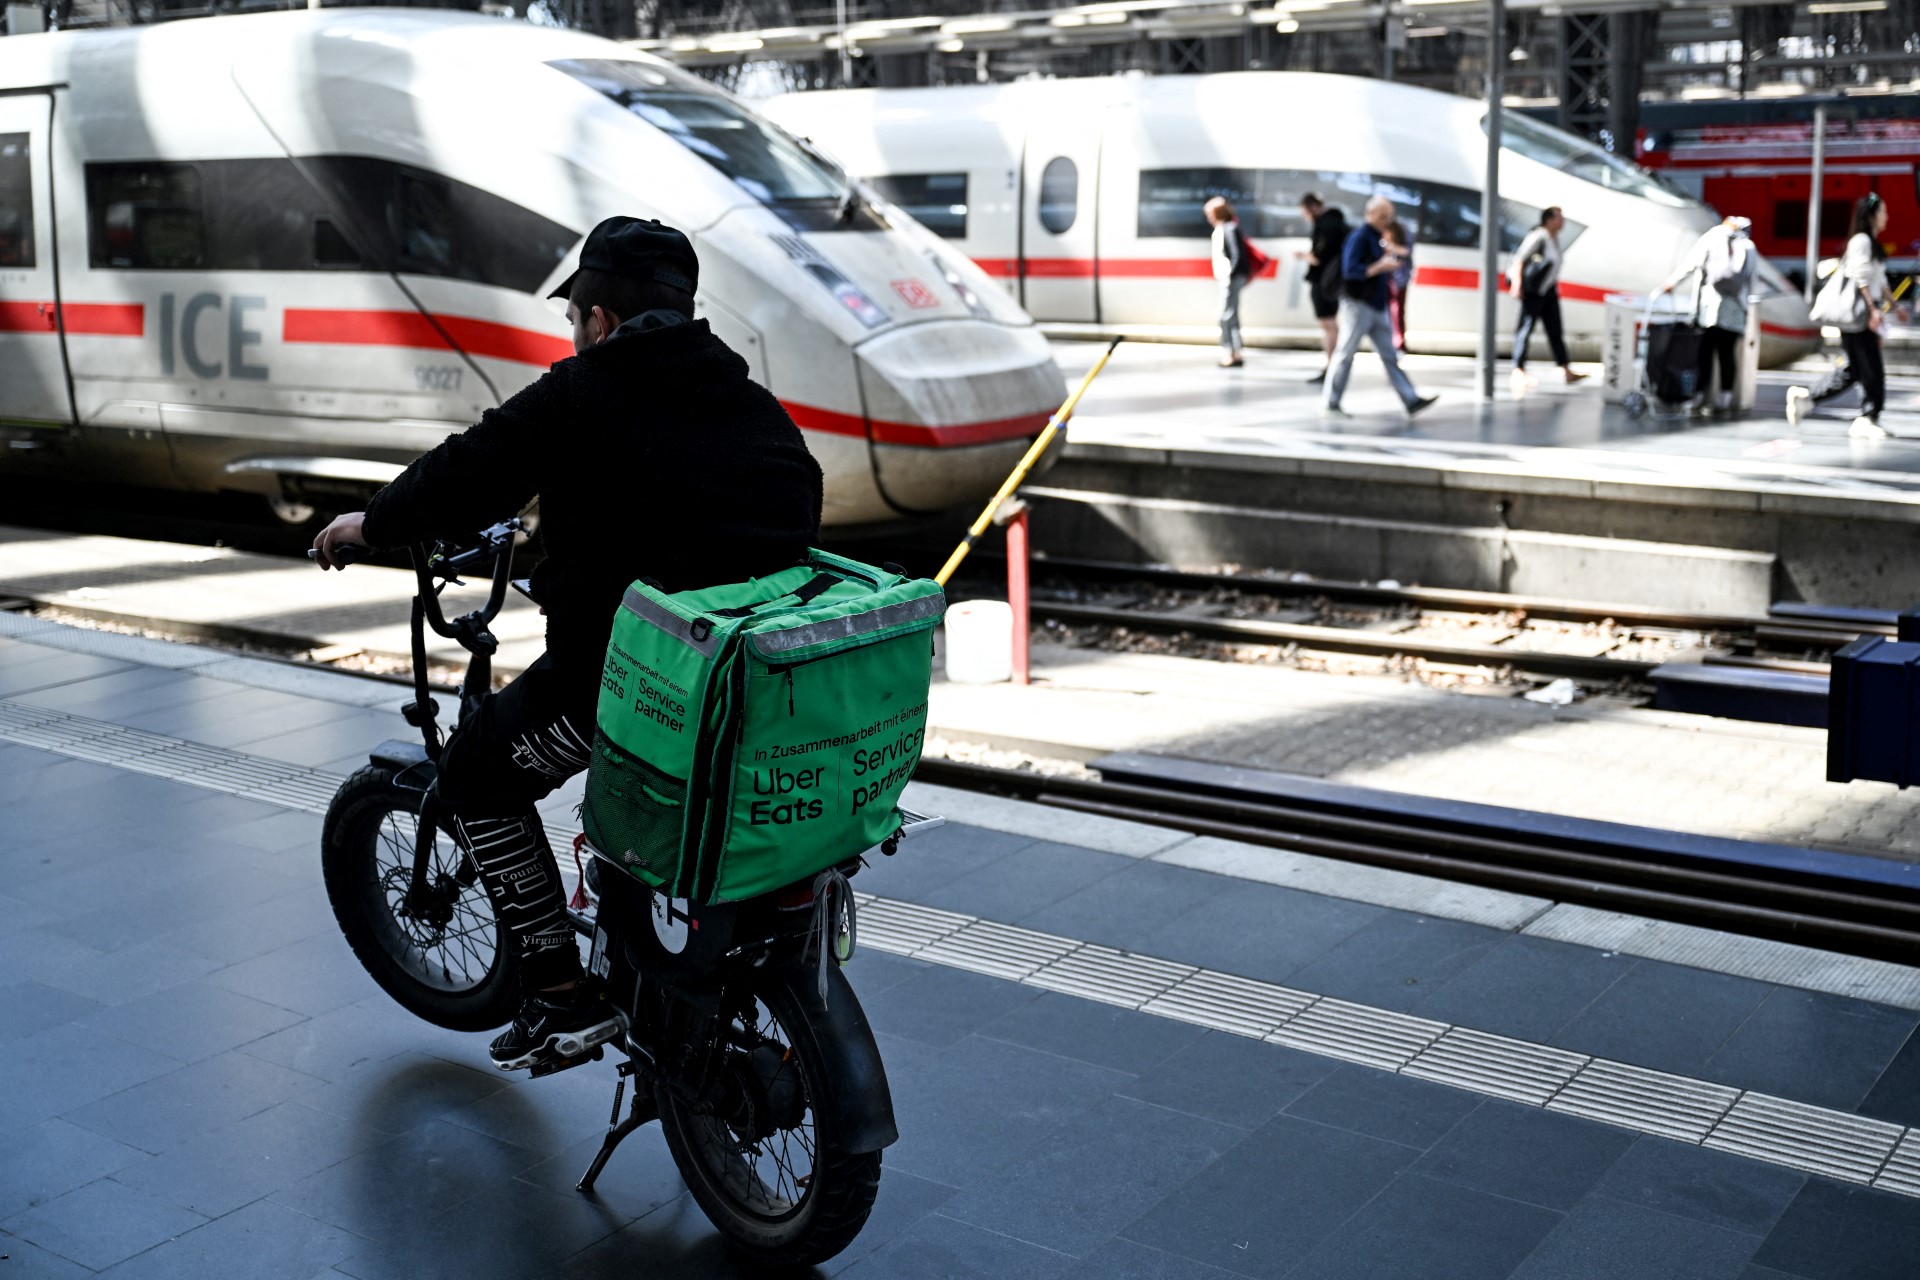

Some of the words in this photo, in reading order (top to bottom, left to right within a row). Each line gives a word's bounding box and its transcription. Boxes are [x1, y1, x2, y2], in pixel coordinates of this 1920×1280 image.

[159, 292, 270, 382] ICE
[414, 364, 463, 391] 9027
[634, 698, 684, 733] partner
[638, 677, 685, 717] Service
[754, 748, 767, 761] In
[770, 721, 882, 759] Zusammenarbeit
[883, 714, 899, 731] mit
[853, 727, 924, 777] Service
[753, 766, 825, 796] Uber
[852, 753, 917, 816] partner
[750, 798, 823, 826] Eats
[500, 861, 544, 884] County
